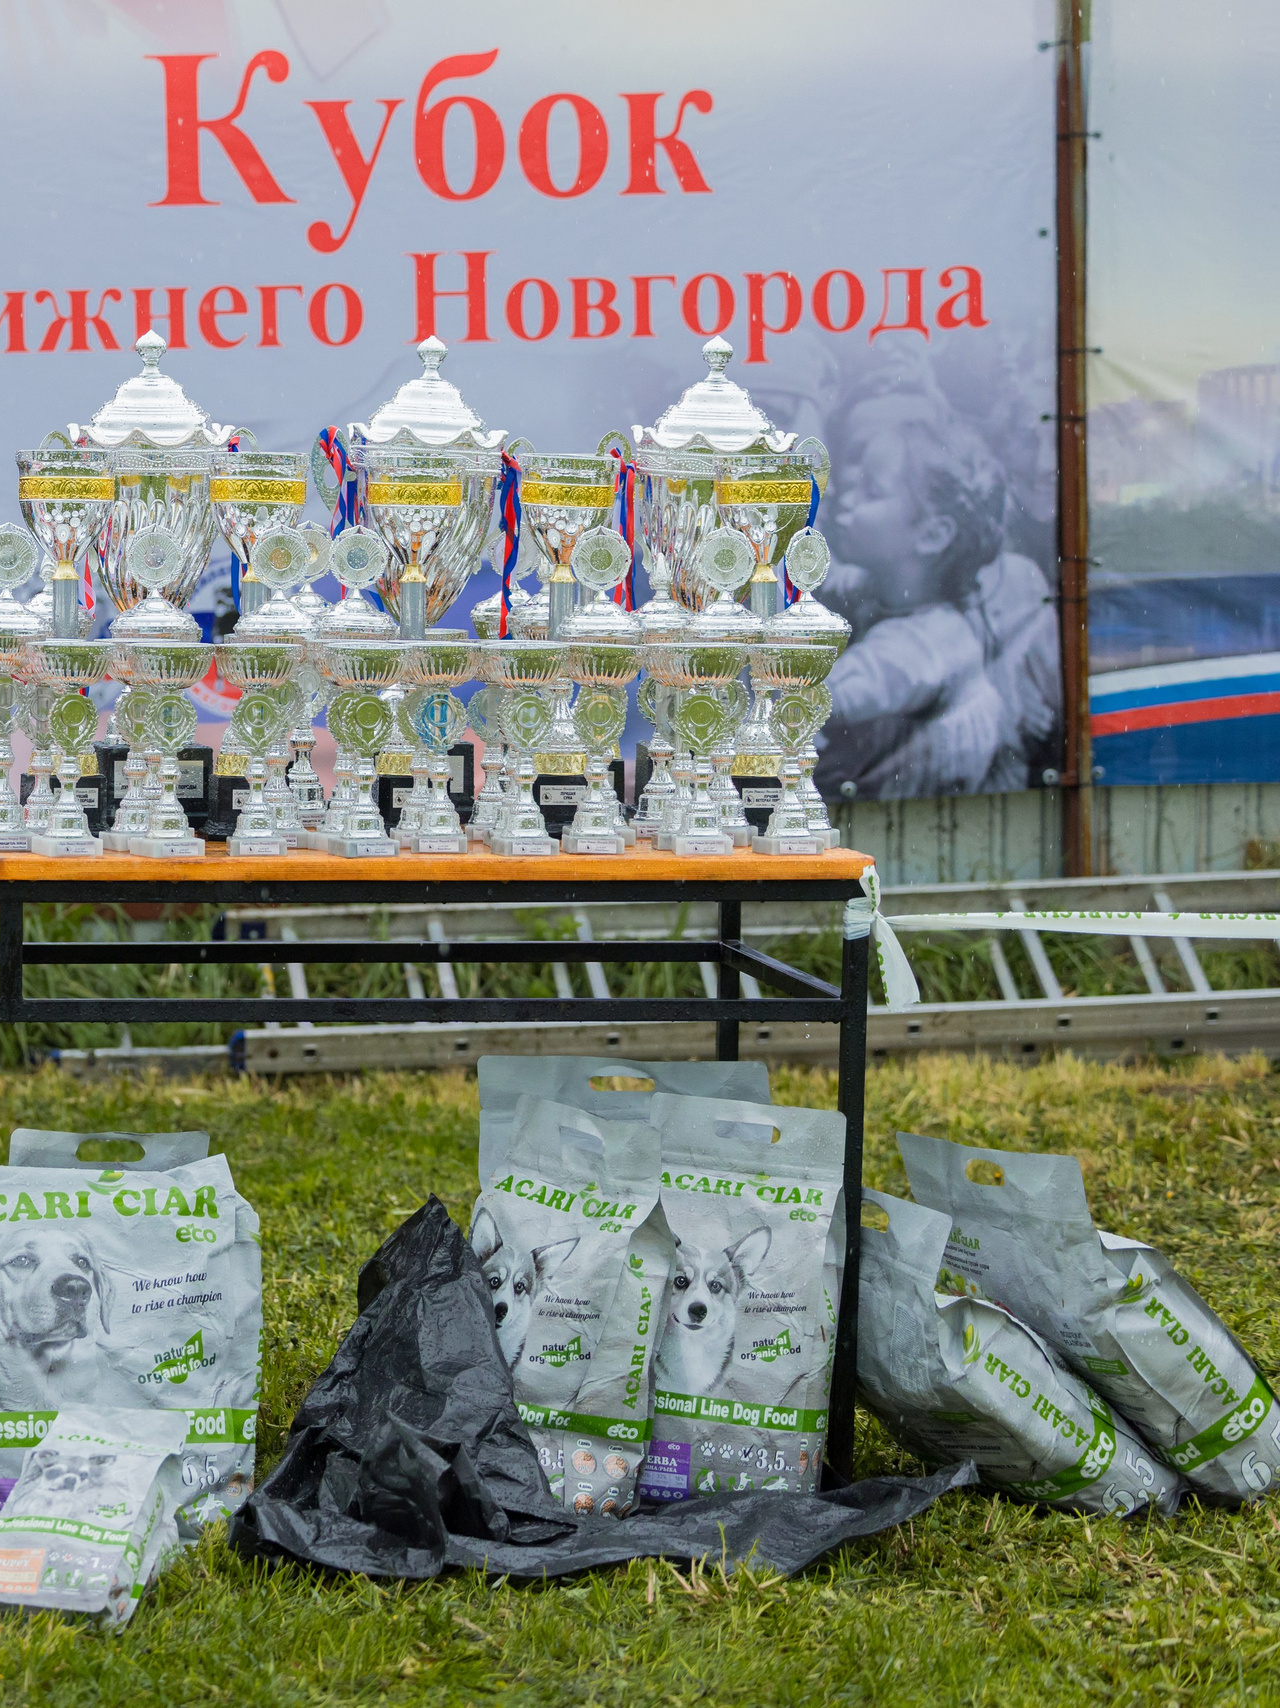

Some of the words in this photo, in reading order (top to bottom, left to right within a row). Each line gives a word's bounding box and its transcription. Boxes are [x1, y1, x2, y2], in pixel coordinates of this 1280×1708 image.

[145, 48, 714, 254] Кубок
[407, 250, 991, 364] Новгорода
[494, 1174, 577, 1213] ACARI
[582, 1198, 637, 1220] CIAR
[660, 1171, 744, 1198] ACARI
[756, 1184, 824, 1206] CIAR
[112, 1185, 220, 1220] CIAR
[599, 1219, 622, 1234] eco
[789, 1208, 817, 1223] eco
[175, 1223, 217, 1244] eco
[131, 1278, 152, 1293] We
[153, 1274, 184, 1291] know
[185, 1269, 208, 1285] how
[131, 1302, 142, 1315] to
[144, 1299, 166, 1313] rise
[167, 1298, 175, 1309] a
[176, 1291, 223, 1308] champion
[543, 1294, 556, 1303] We
[556, 1295, 574, 1305] know
[574, 1296, 591, 1306] how
[747, 1290, 760, 1300] We
[761, 1290, 779, 1300] know
[780, 1289, 796, 1299] how
[538, 1308, 546, 1317] to
[547, 1309, 561, 1318] rise
[566, 1311, 601, 1322] champion
[744, 1305, 751, 1314] to
[752, 1305, 765, 1314] rise
[772, 1304, 807, 1314] champion
[153, 1340, 200, 1364] natural
[541, 1341, 578, 1352] natural
[740, 1347, 778, 1361] organic
[778, 1344, 802, 1358] food
[752, 1335, 787, 1349] natural
[1144, 1296, 1190, 1346] CIAR
[1185, 1345, 1241, 1407] ACARI
[137, 1364, 189, 1386] organic
[189, 1352, 217, 1375] food
[529, 1351, 567, 1365] organic
[568, 1350, 591, 1363] food
[622, 1344, 646, 1409] ACARI
[699, 1396, 731, 1421] Line
[732, 1402, 760, 1426] Dog
[763, 1403, 798, 1427] Food
[984, 1352, 1031, 1398] CIAR
[1031, 1393, 1091, 1448] ACARI
[187, 1410, 226, 1435] Food
[517, 1403, 545, 1427] Dog
[1222, 1397, 1265, 1442] eco
[606, 1422, 639, 1440] eco
[540, 1447, 565, 1470] 3,5
[647, 1454, 678, 1468] ERBA
[757, 1449, 786, 1472] 3,5
[1080, 1431, 1115, 1479] eco
[181, 1454, 221, 1487] 6,5
[55, 1520, 78, 1534] Line
[79, 1524, 101, 1540] Dog
[103, 1531, 130, 1543] Food
